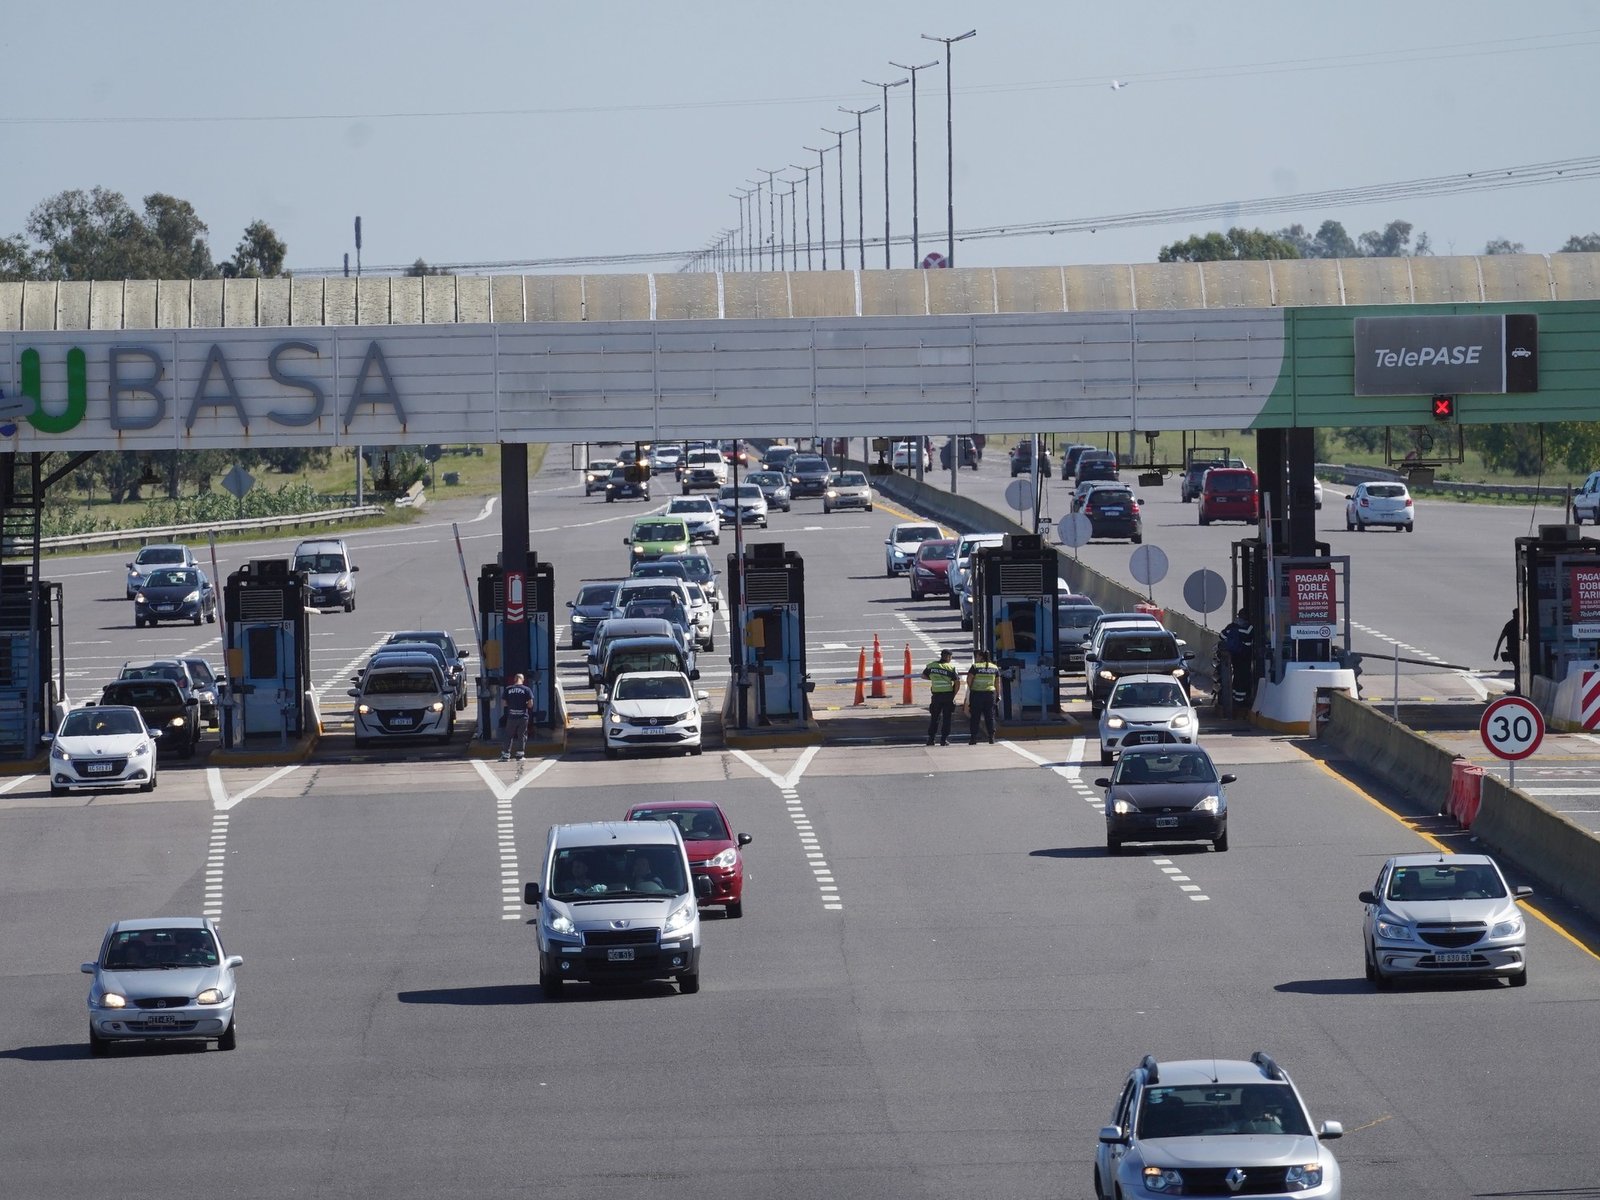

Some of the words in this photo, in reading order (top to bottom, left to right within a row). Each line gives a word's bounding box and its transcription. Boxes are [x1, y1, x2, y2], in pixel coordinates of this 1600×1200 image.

[1374, 345, 1483, 367] TelePASE
[1295, 572, 1330, 582] PAGARÁ
[1576, 573, 1600, 581] PAGA
[1297, 583, 1328, 591] DOBLE
[1297, 592, 1329, 600] TARIFA
[1578, 591, 1600, 599] TARI
[1492, 716, 1532, 742] 30
